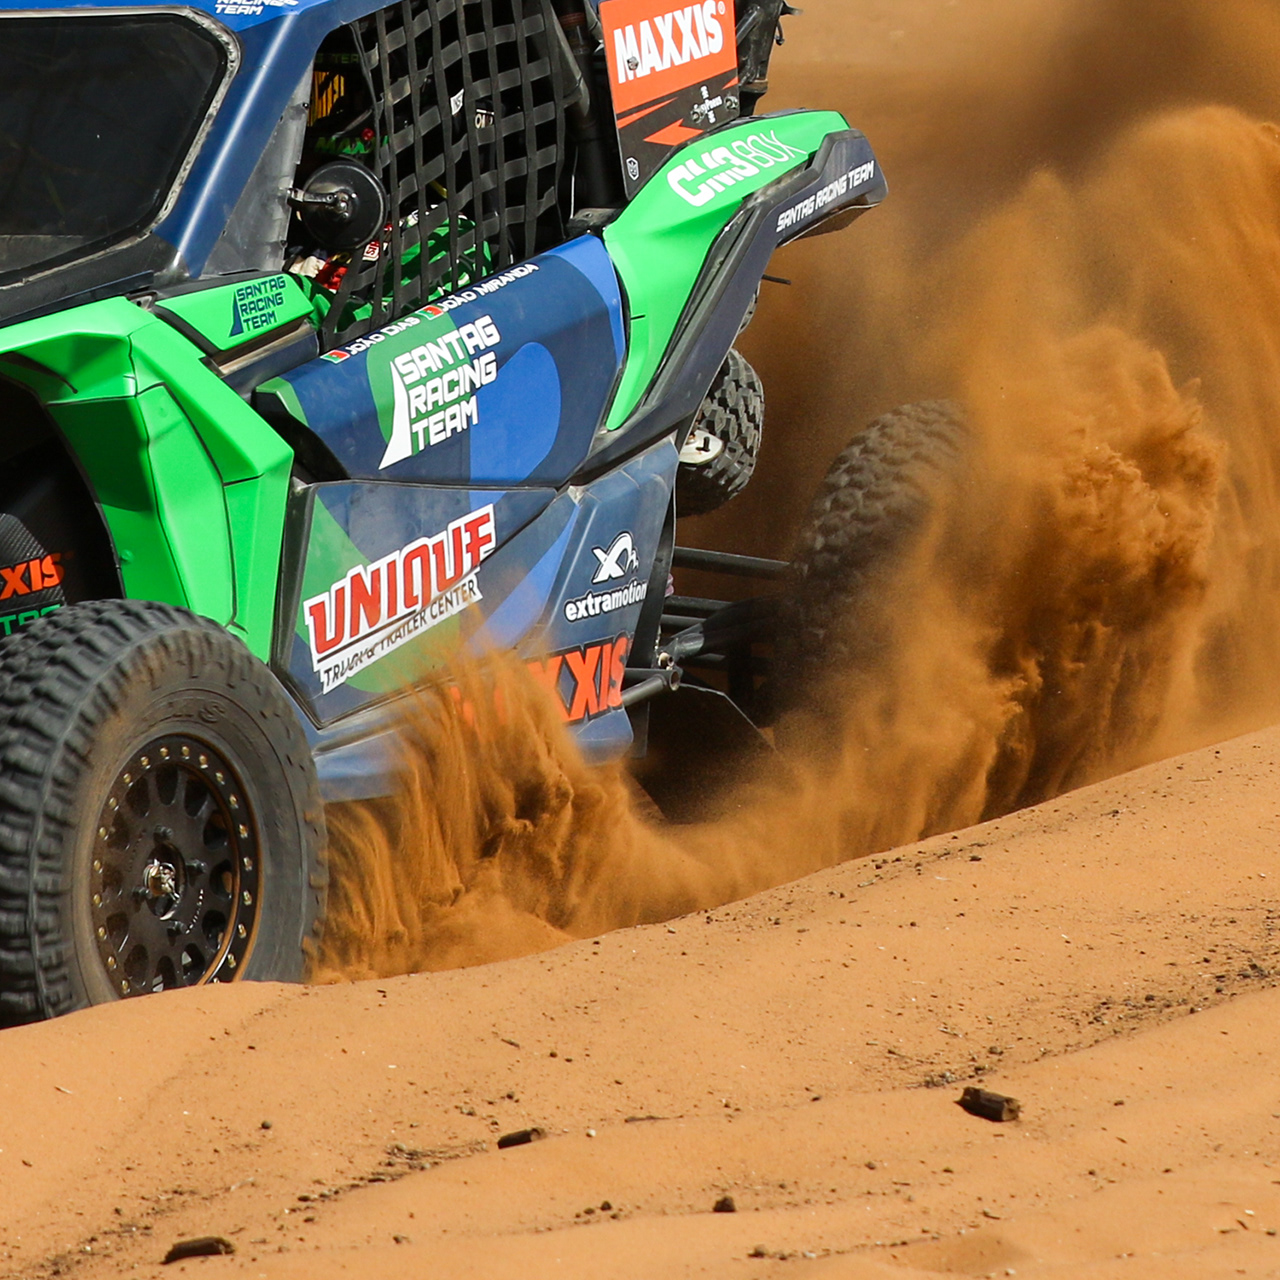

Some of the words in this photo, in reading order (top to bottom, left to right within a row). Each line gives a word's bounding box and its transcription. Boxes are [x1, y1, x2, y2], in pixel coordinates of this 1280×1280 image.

[214, 4, 263, 15] TEAM
[613, 0, 724, 84] MAXXIS
[776, 196, 814, 233] SANTAG
[814, 174, 847, 211] RACING
[847, 160, 874, 189] TEAM
[236, 276, 286, 302] SANTAG
[240, 292, 284, 317] RACING
[436, 291, 478, 313] JOÃO
[472, 263, 539, 297] MIRANDA
[243, 310, 277, 332] TEAM
[345, 333, 386, 356] JOÃO
[380, 316, 421, 337] DIAS
[394, 314, 501, 385] SANTAG
[408, 351, 498, 420] RACING
[411, 394, 479, 452] TEAM
[430, 579, 477, 620] CENTER
[565, 580, 647, 622] extramotion
